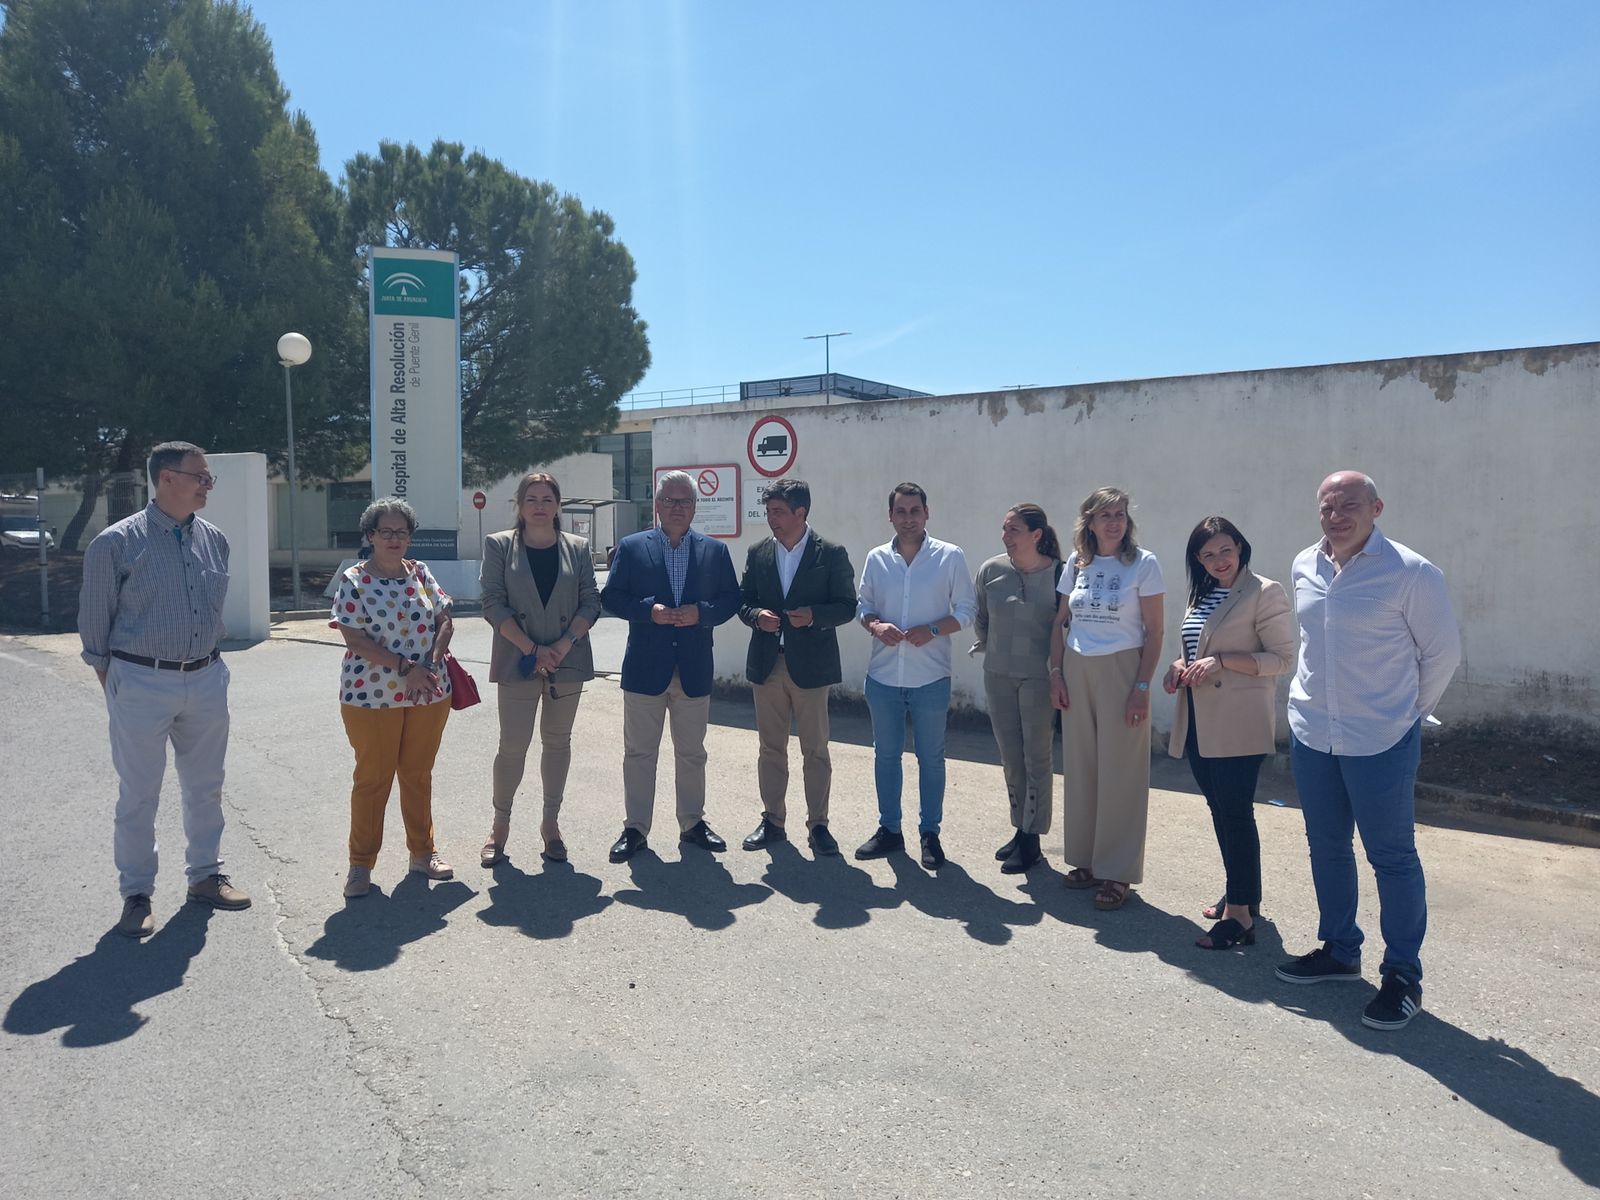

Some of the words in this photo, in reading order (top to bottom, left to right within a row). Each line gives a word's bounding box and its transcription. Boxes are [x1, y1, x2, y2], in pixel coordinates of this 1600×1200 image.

[408, 322, 420, 343] Genil
[389, 322, 406, 394] Resolución
[408, 345, 420, 374] Puente
[409, 376, 421, 388] de
[390, 398, 406, 425] Alta
[390, 428, 407, 445] de
[748, 510, 760, 518] DEL
